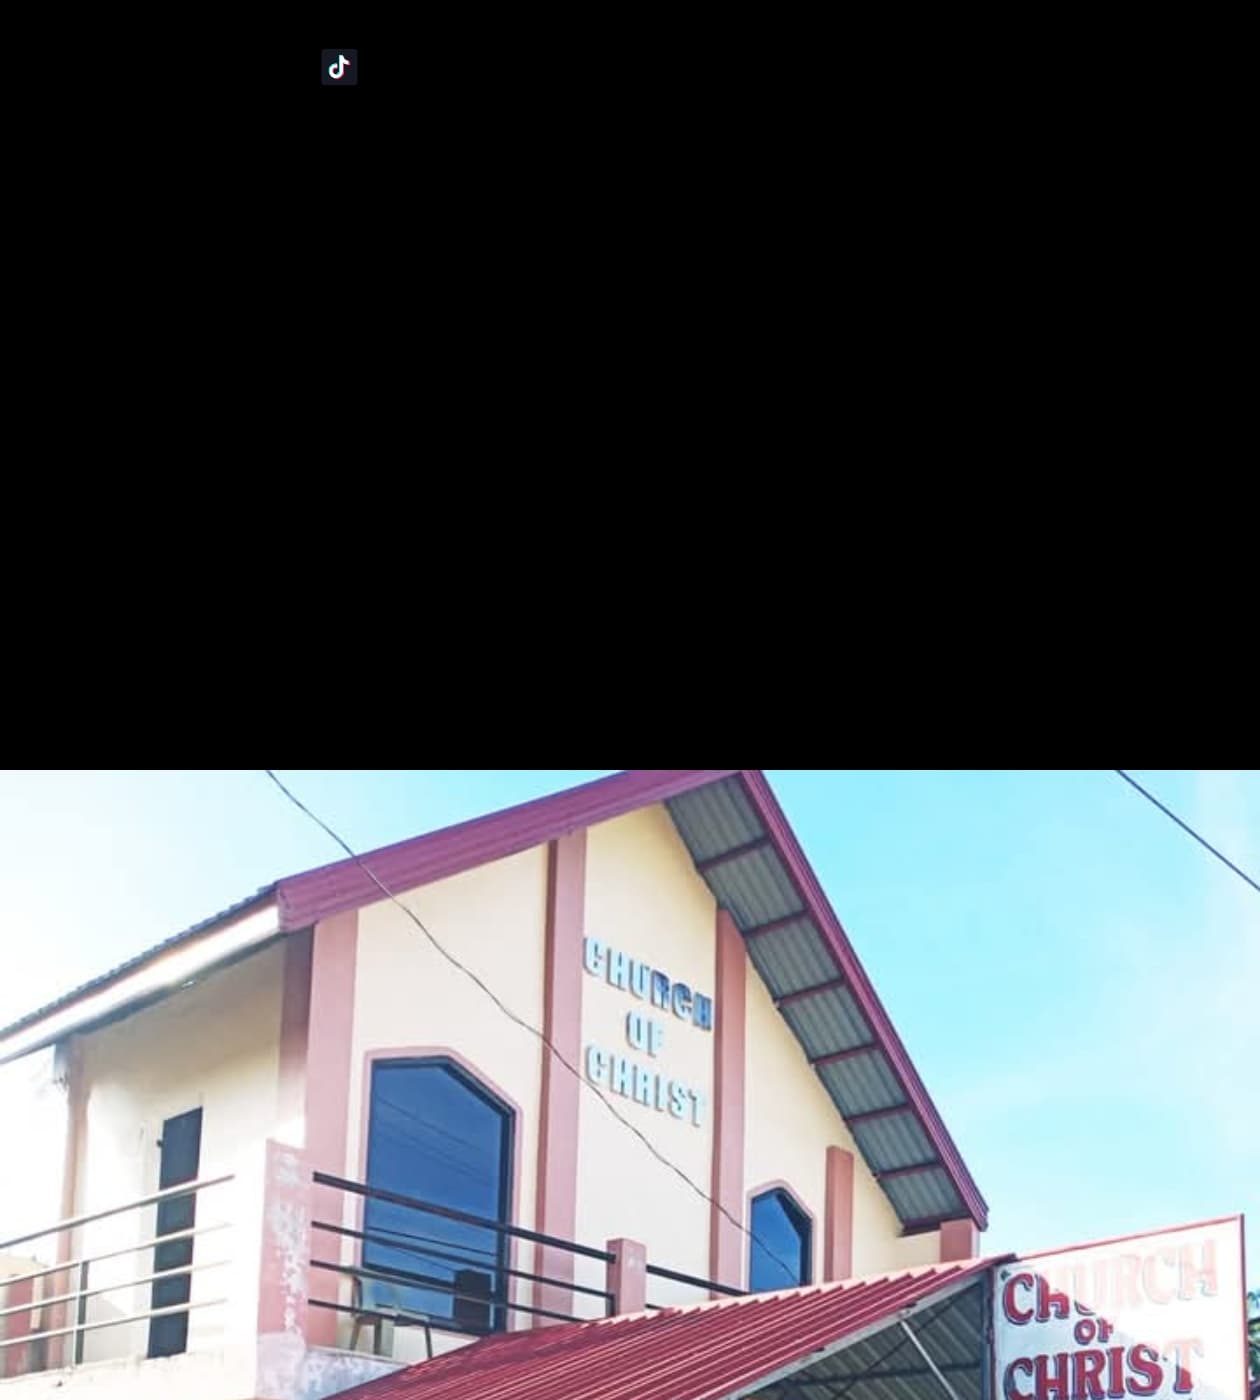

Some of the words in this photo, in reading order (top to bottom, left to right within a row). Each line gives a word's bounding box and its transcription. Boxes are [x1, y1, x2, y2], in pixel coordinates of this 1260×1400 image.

[583, 936, 713, 1031] CHURCH
[626, 1010, 664, 1058] OF
[585, 1046, 706, 1128] CHRIST
[1003, 1240, 1218, 1325] CHURCH
